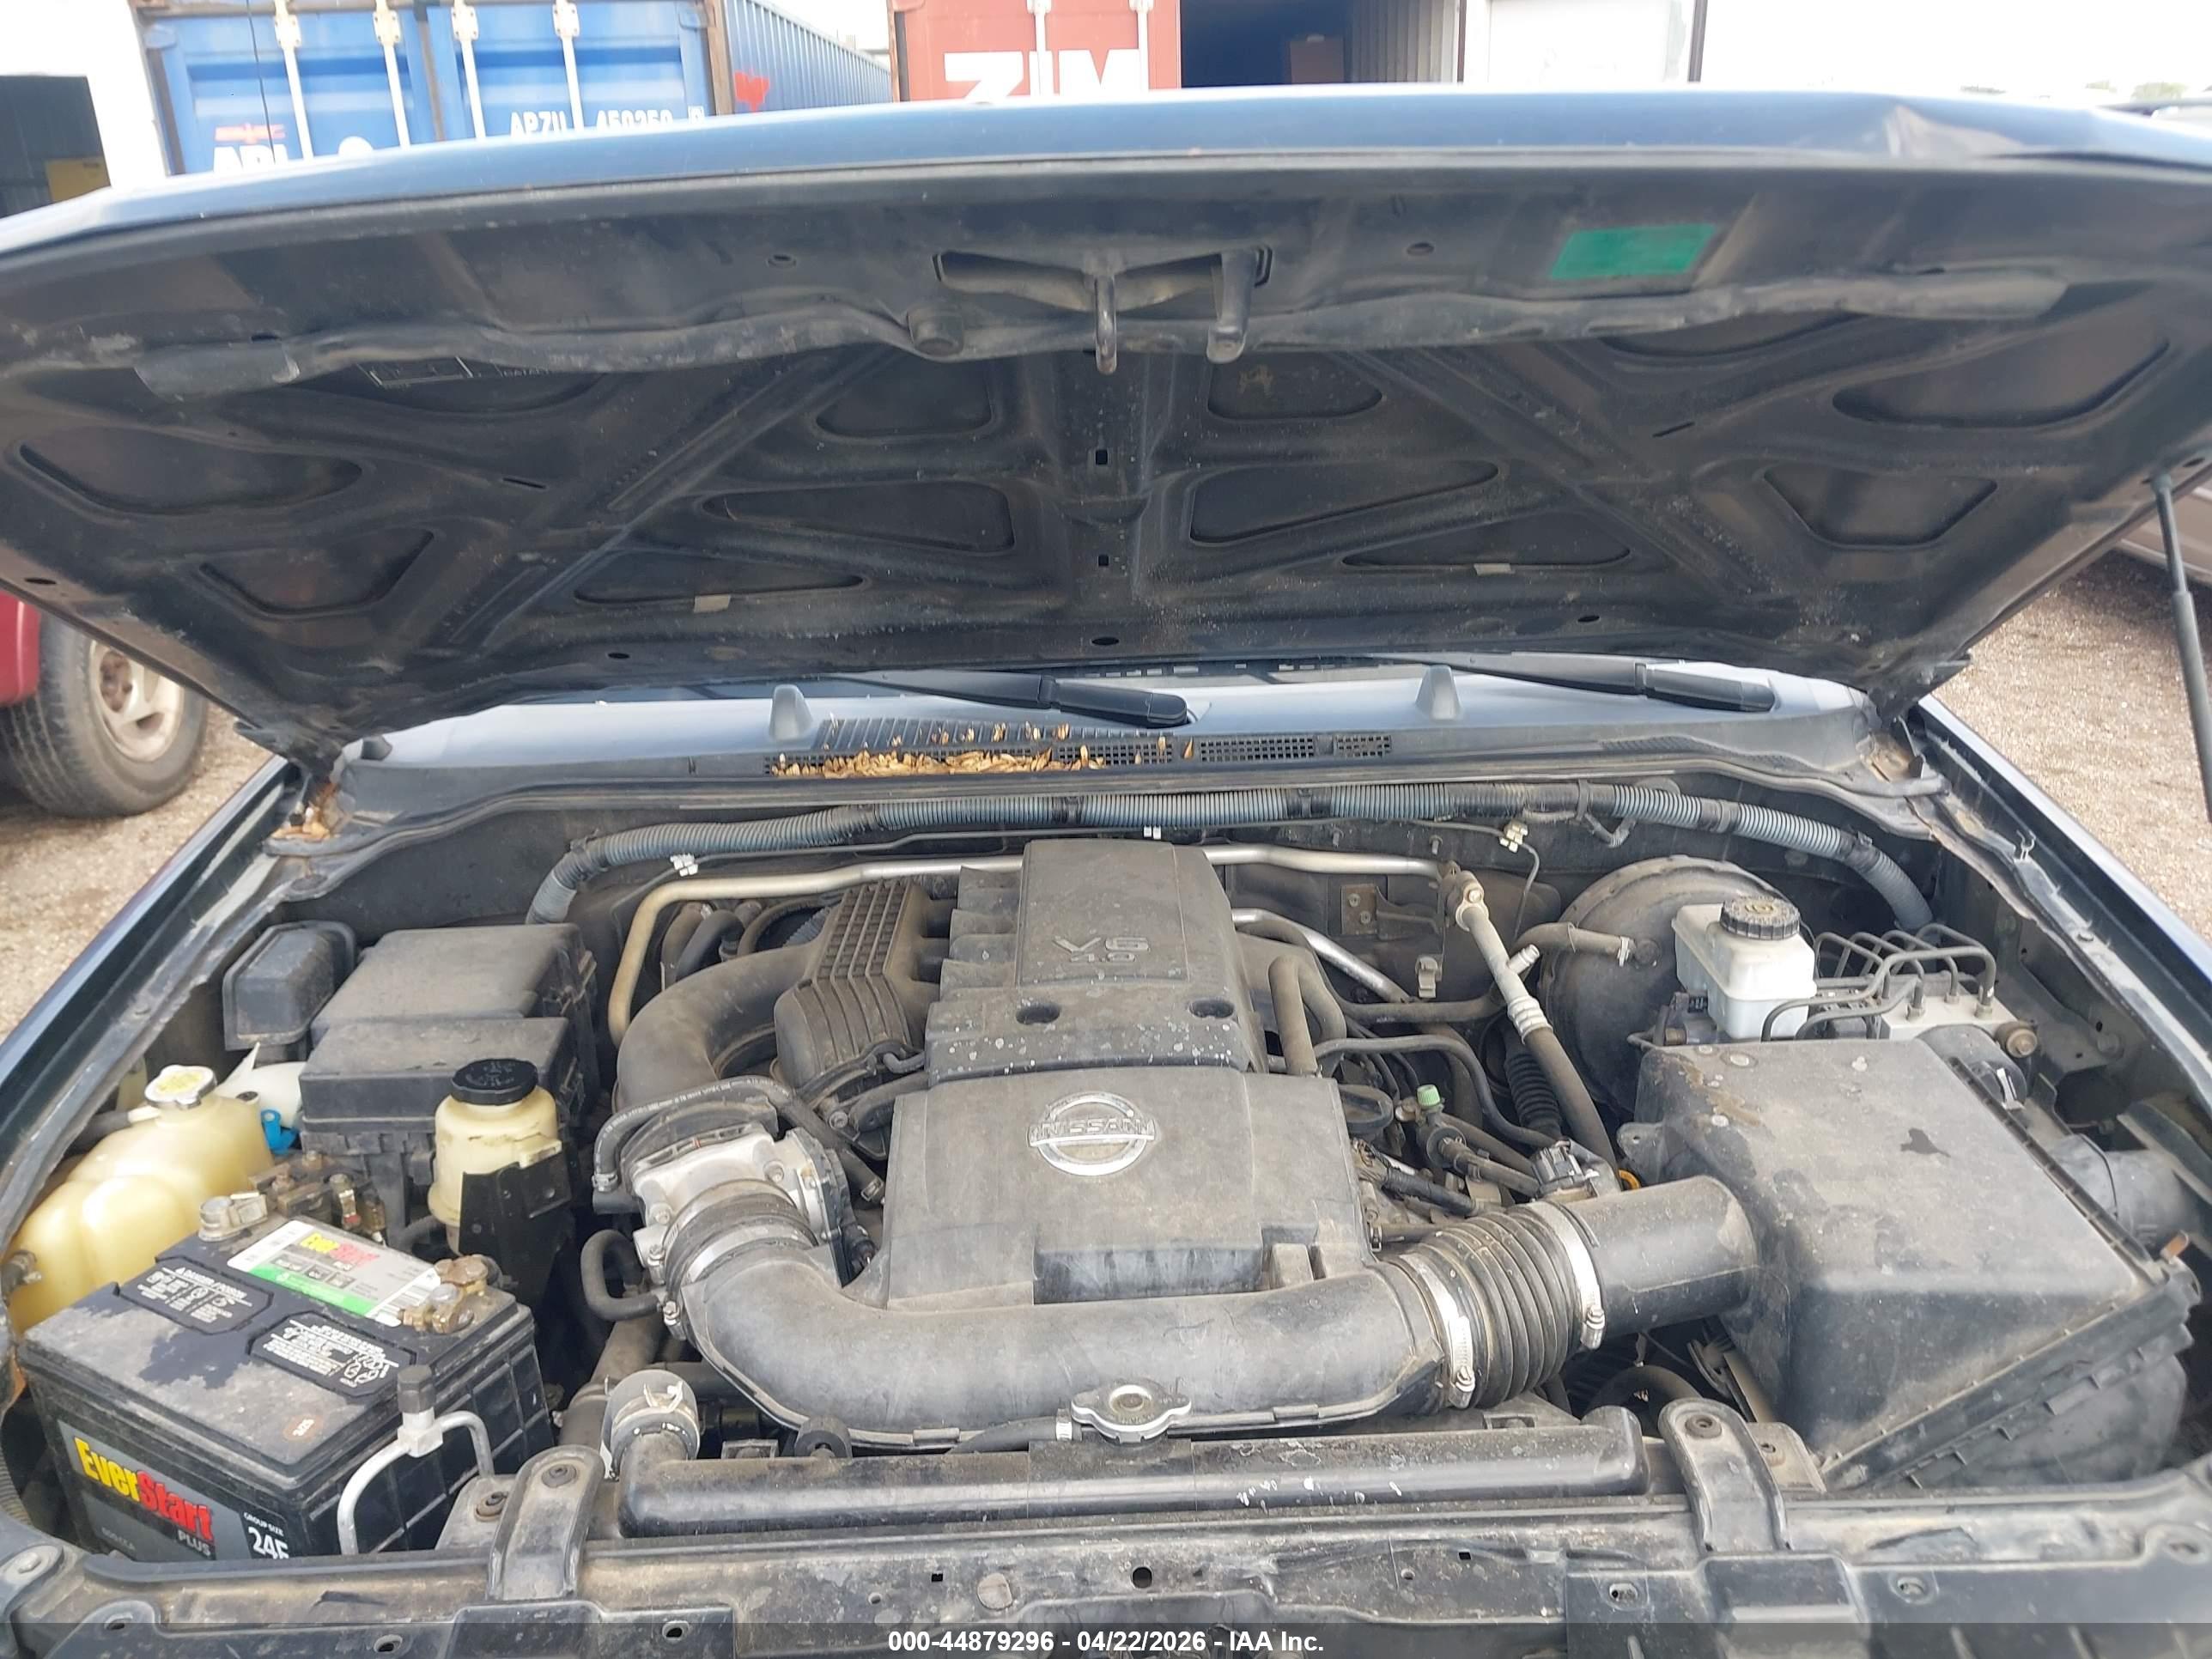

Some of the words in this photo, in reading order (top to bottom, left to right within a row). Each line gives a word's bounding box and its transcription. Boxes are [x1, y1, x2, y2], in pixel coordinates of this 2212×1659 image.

[1041, 1116, 1141, 1135] NISSAN
[74, 1436, 214, 1541] EverStart
[243, 1511, 268, 1528] GROUP
[268, 1523, 284, 1537] SIZE
[177, 1528, 212, 1557] PLUS
